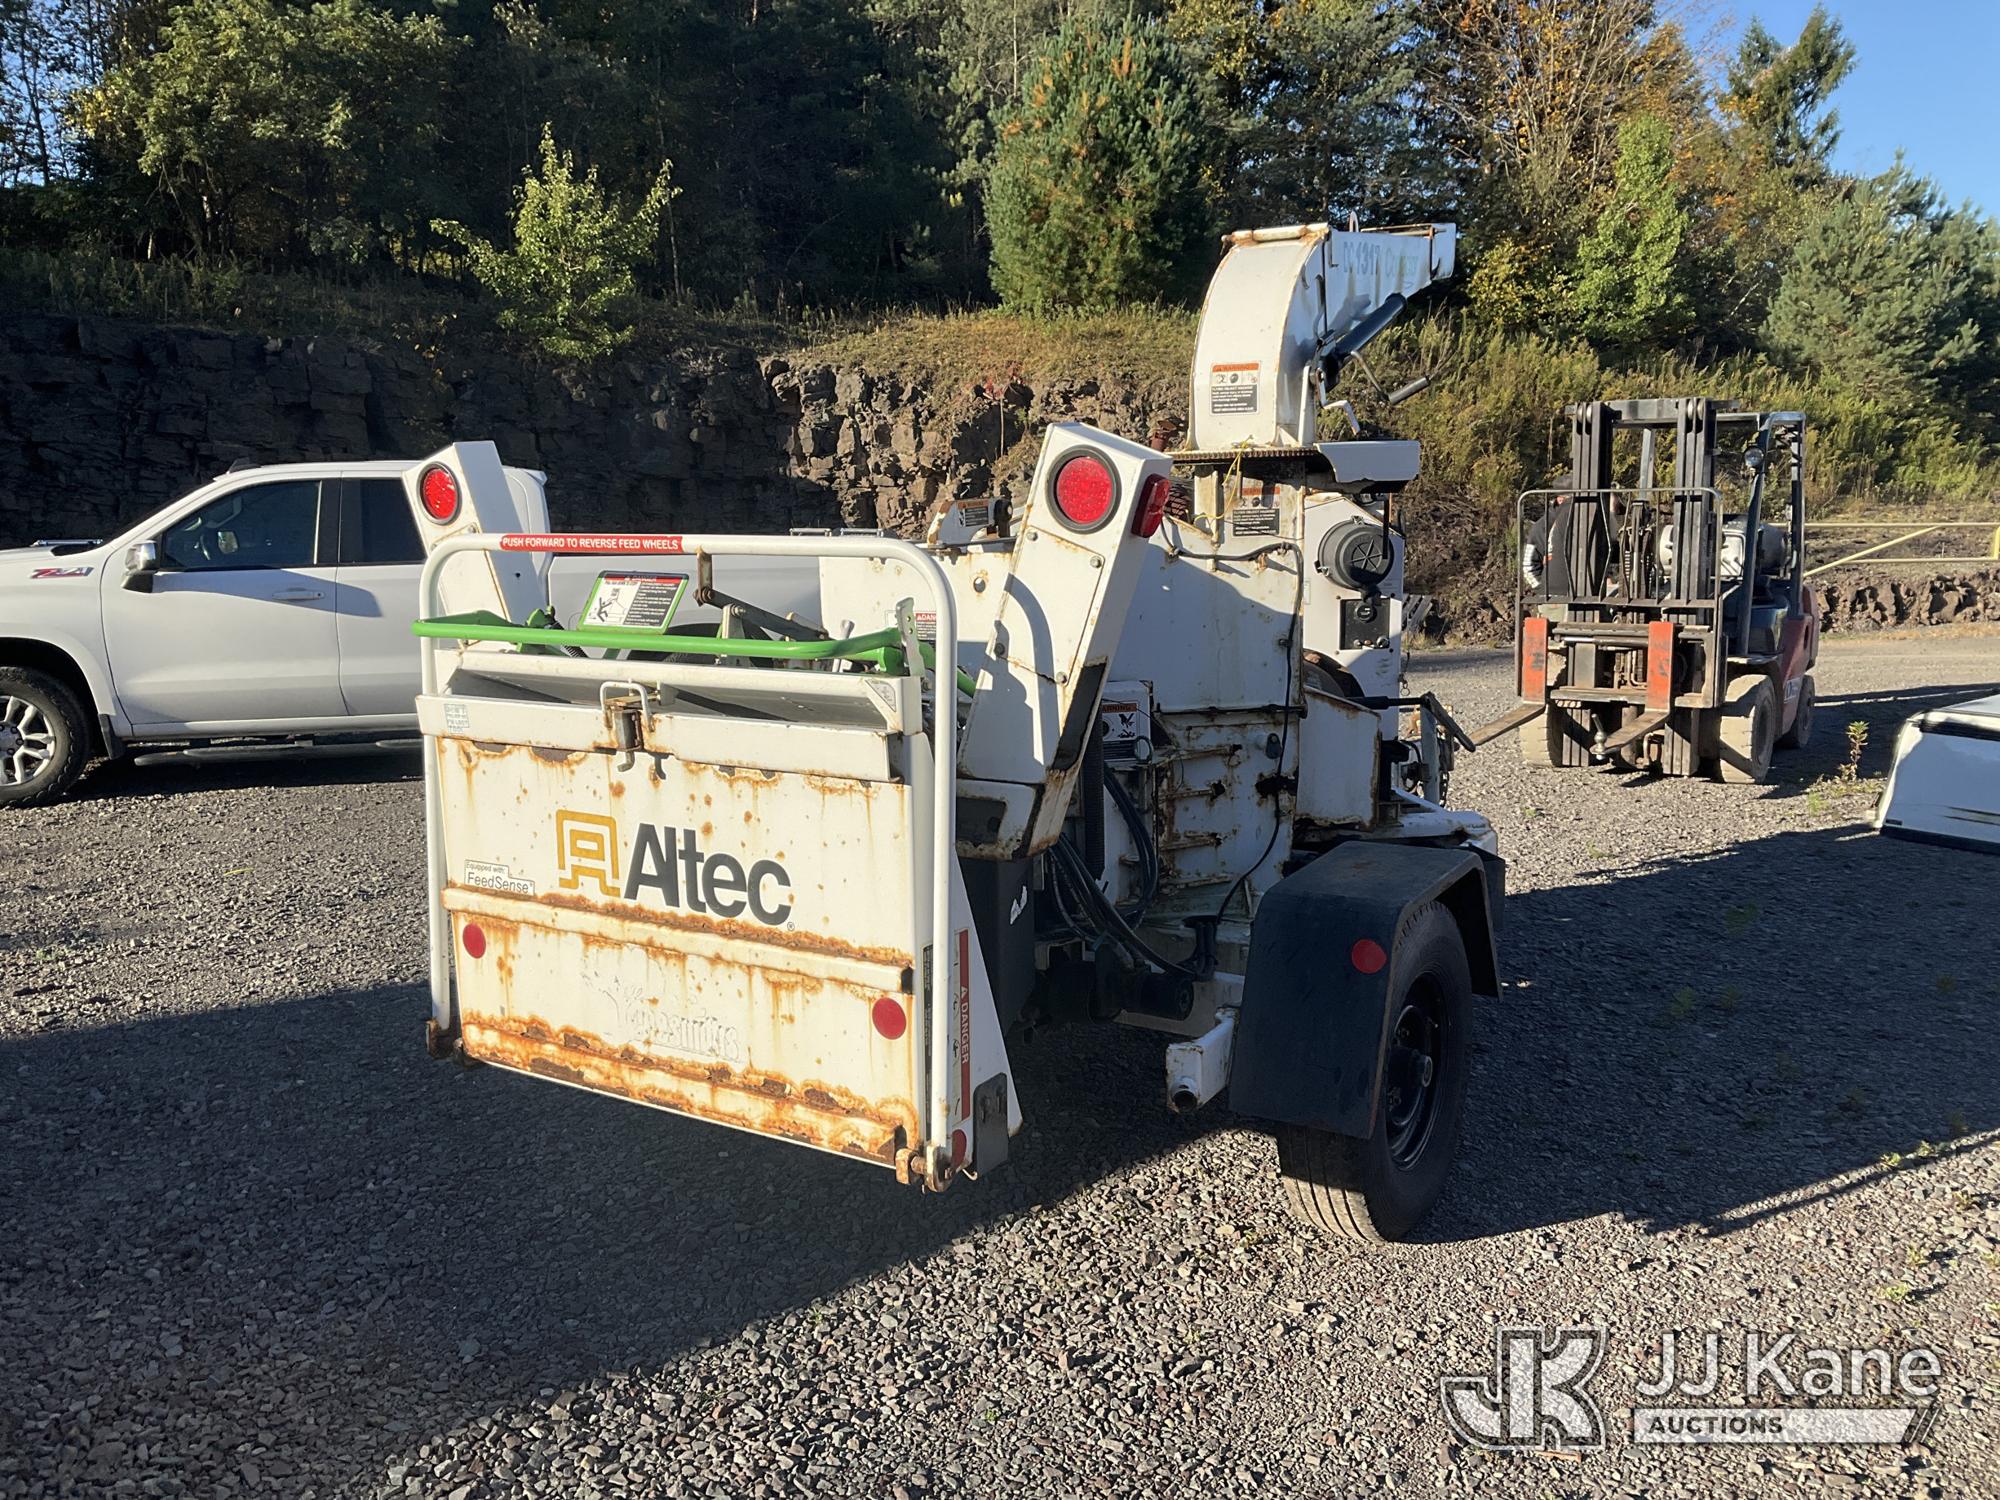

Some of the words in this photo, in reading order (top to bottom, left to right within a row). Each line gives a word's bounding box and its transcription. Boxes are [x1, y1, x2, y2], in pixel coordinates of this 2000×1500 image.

[502, 537, 524, 547] PUSH
[525, 537, 565, 548] FORWARD
[567, 538, 578, 548] TO
[579, 538, 618, 549] REVERSE
[619, 538, 641, 549] FEED
[642, 539, 679, 550] WHEELS
[466, 861, 492, 872] Equipped
[623, 822, 792, 926] Altec
[467, 871, 529, 894] FeedSense
[960, 1002, 969, 1064] DANGER
